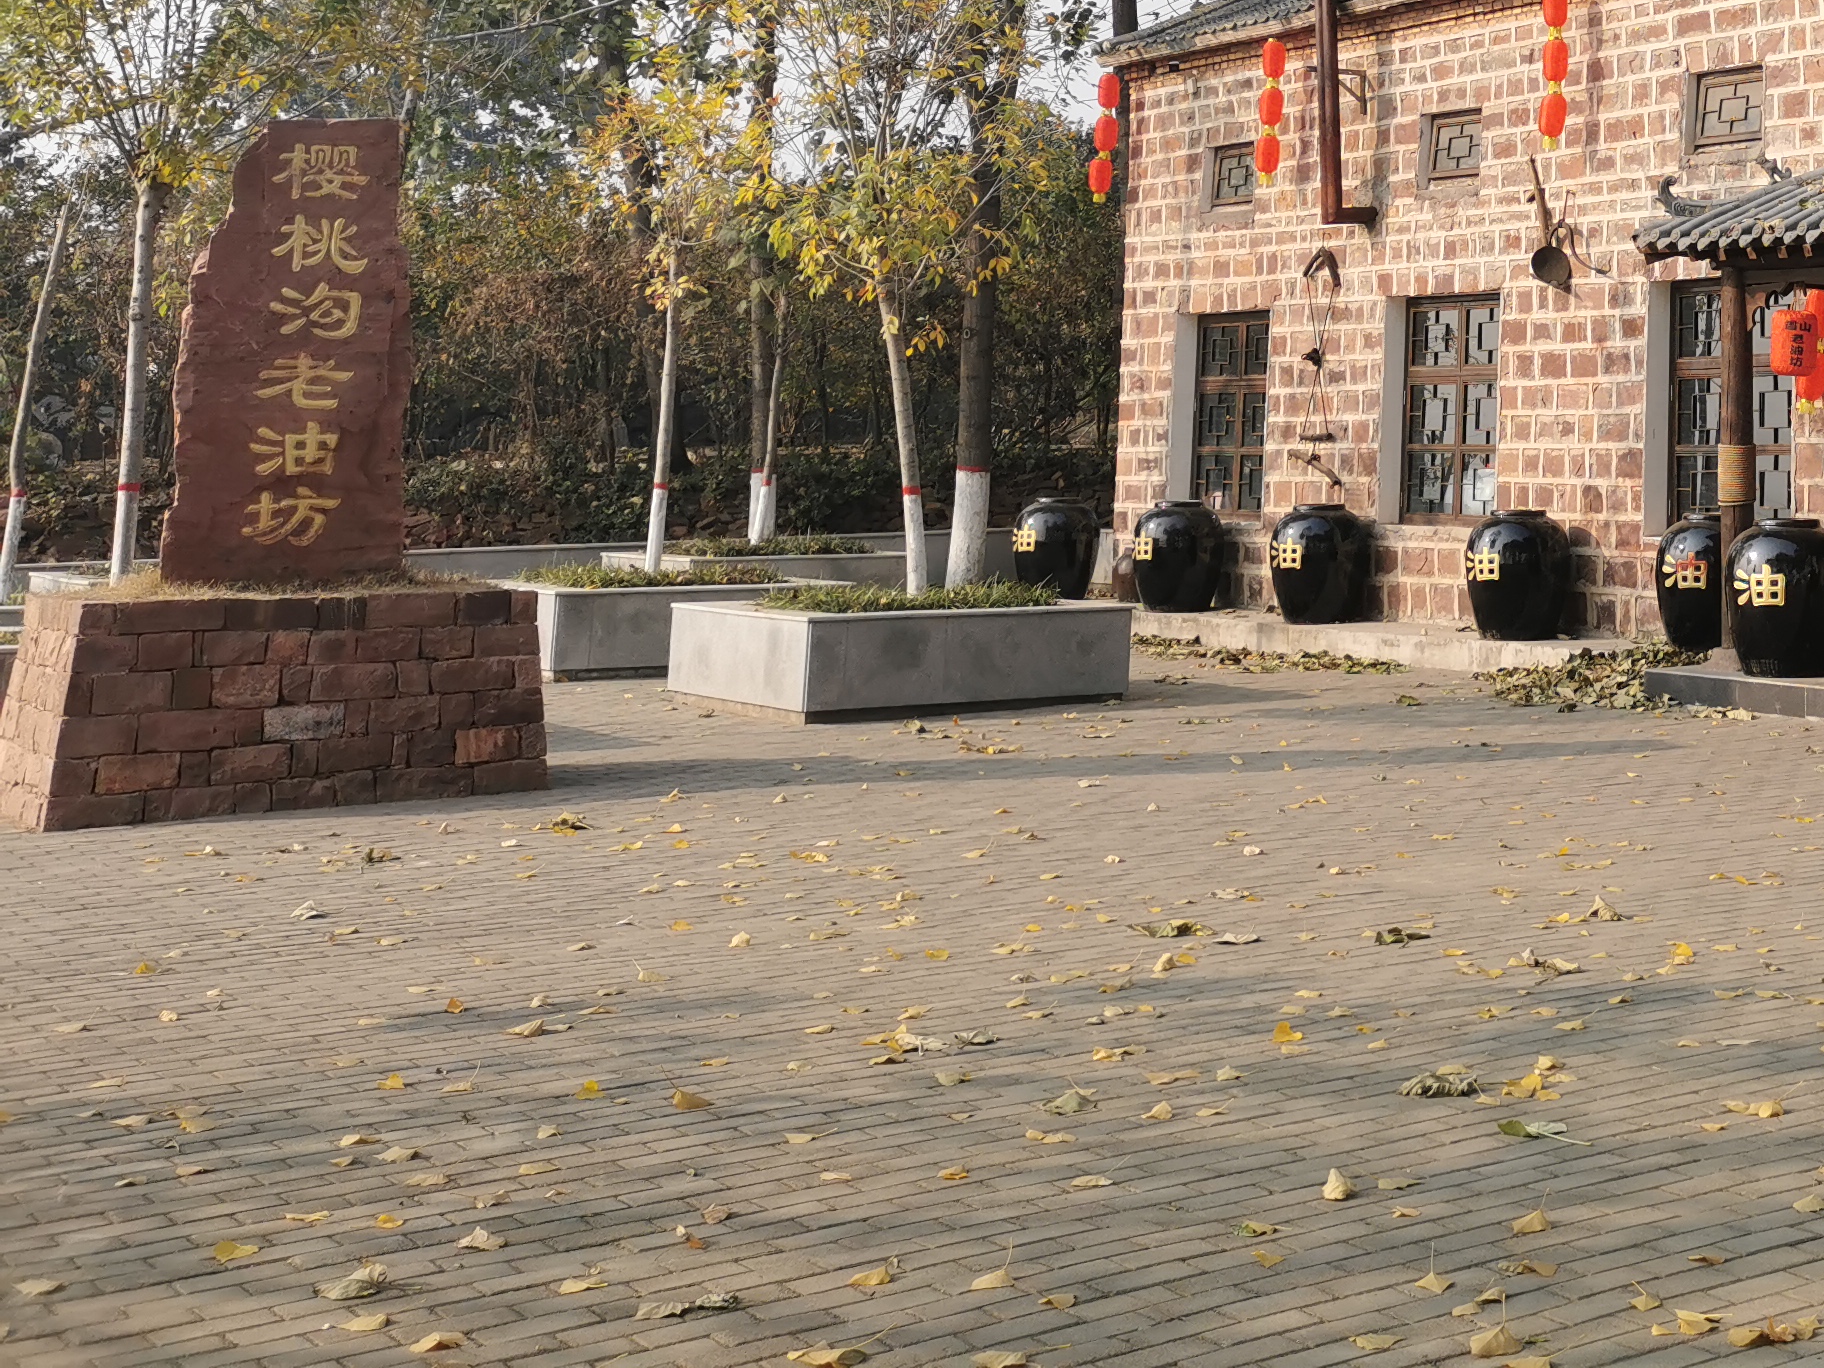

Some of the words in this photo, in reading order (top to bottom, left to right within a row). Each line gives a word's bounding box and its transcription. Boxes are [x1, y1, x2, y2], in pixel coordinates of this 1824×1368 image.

[240, 143, 371, 547] 樱桃沟老油坊
[1012, 523, 1037, 553] 油
[1271, 537, 1303, 570] 油
[1466, 546, 1500, 582] 油
[1662, 551, 1708, 590] 油
[1733, 563, 1786, 607] 油
